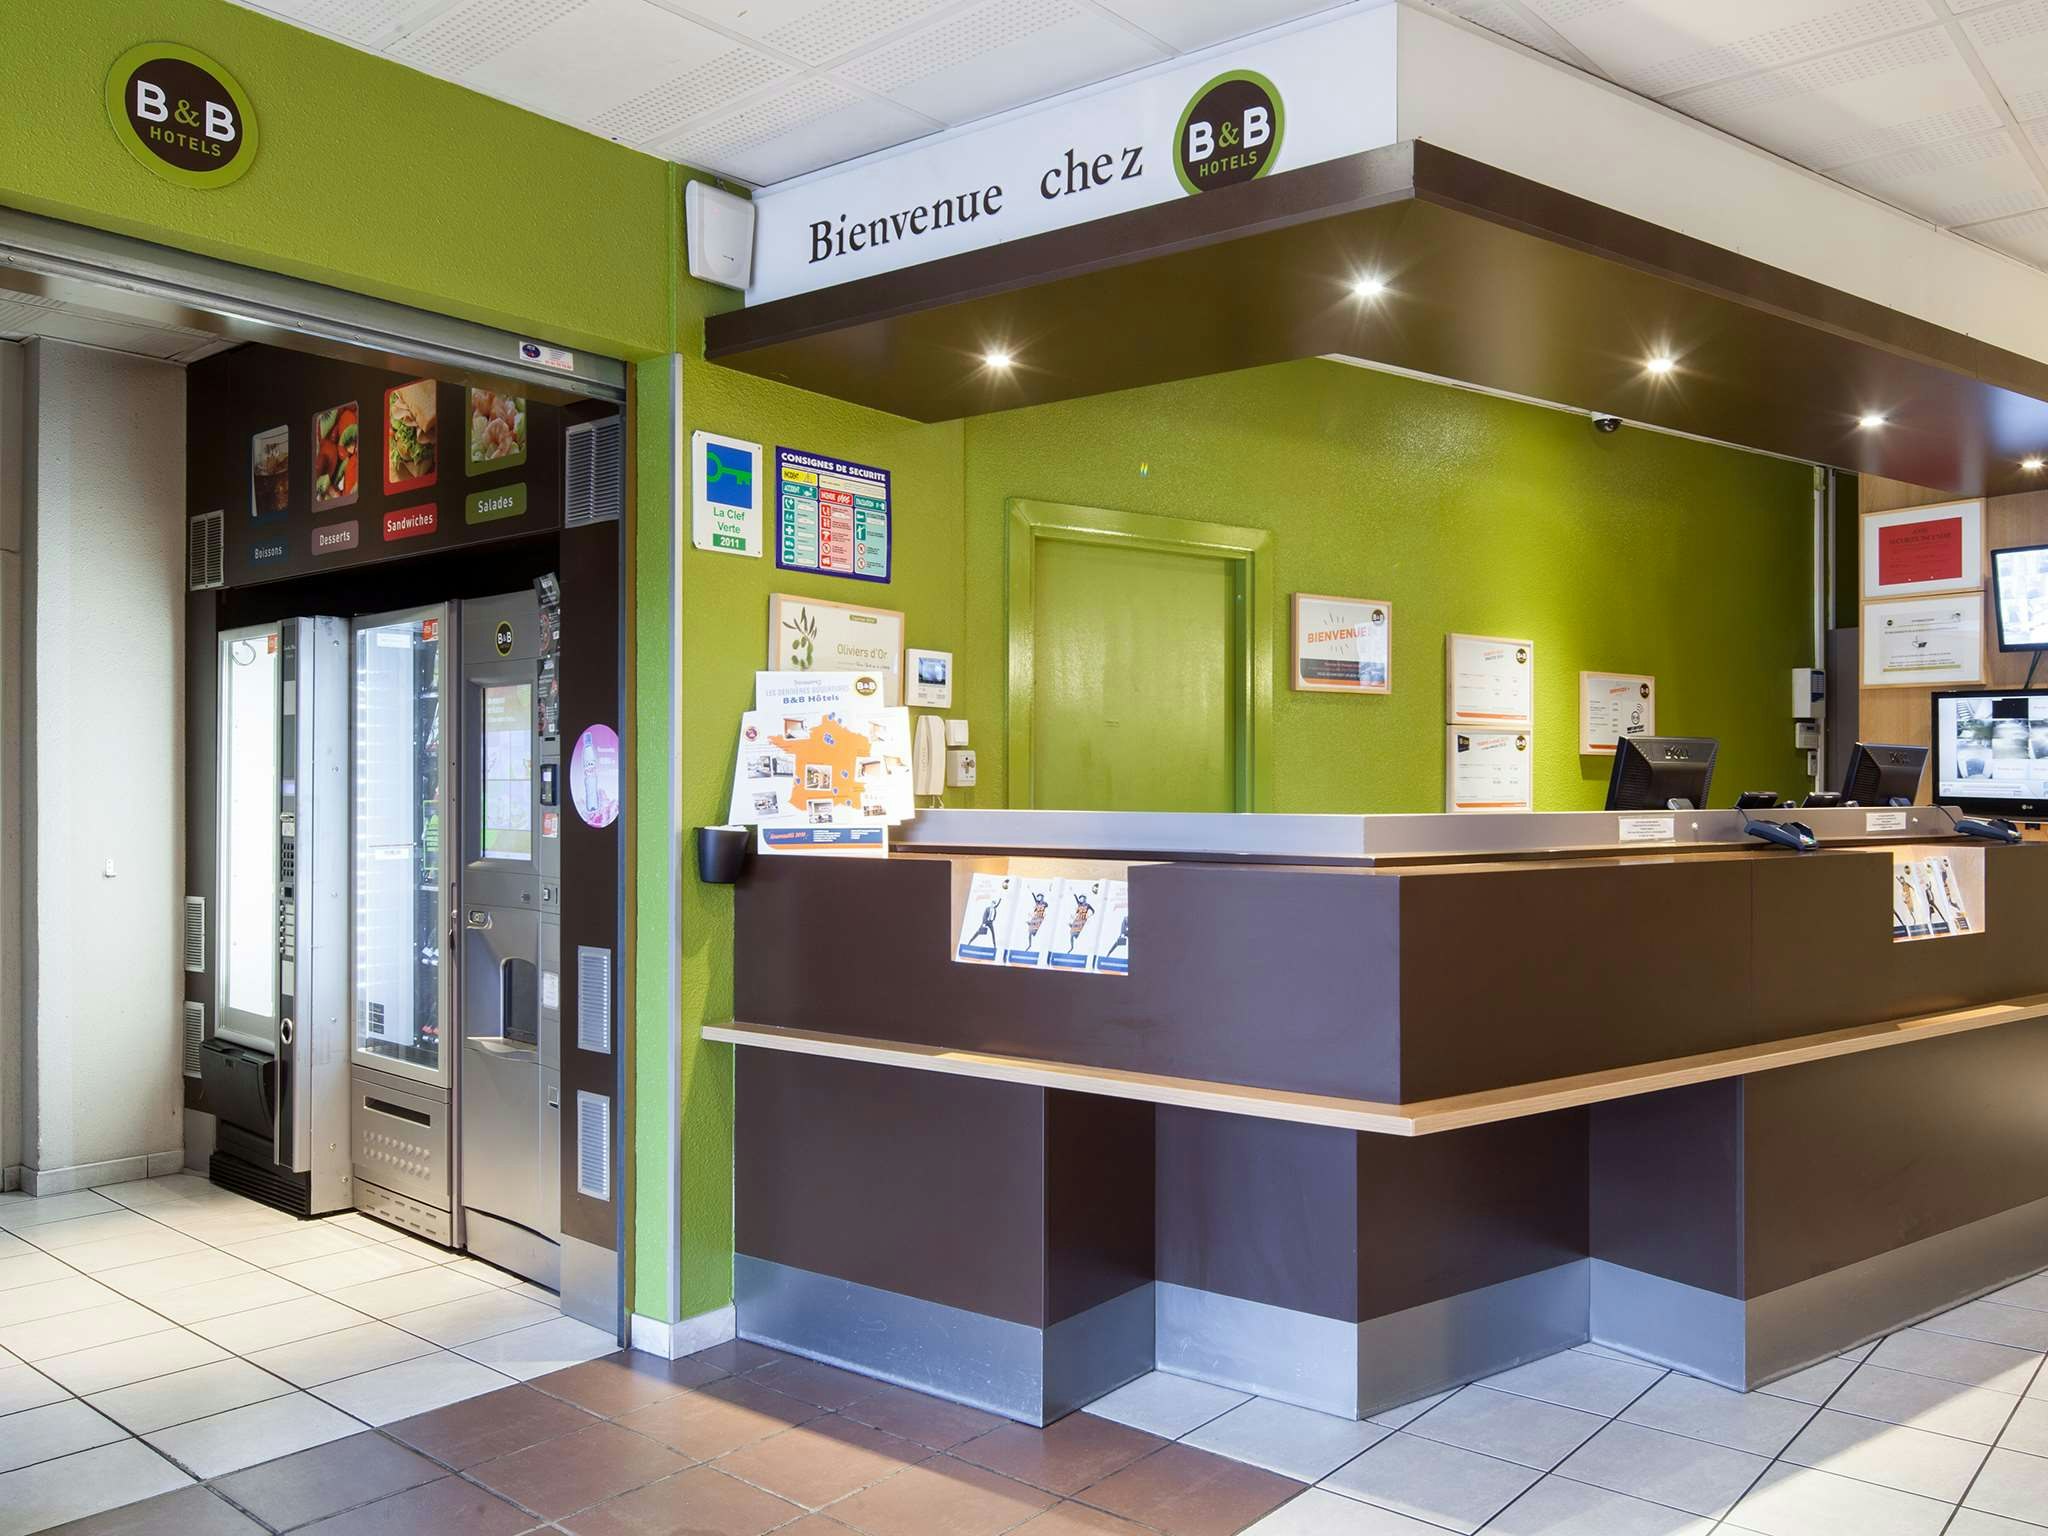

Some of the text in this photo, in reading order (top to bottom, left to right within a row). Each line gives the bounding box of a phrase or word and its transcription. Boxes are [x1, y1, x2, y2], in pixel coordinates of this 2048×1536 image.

[150, 126, 222, 157] HOTELS
[1199, 151, 1258, 177] HOTELS
[808, 145, 1143, 264] Bienvenue chez
[781, 452, 886, 482] CONSIGNES DE SECURITE
[477, 495, 514, 513] Salades
[713, 506, 745, 520] La Clef
[387, 513, 433, 533] Sandwiches
[717, 521, 741, 534] Verte
[319, 530, 351, 546] Desserts
[720, 536, 740, 548] 2011
[254, 544, 283, 560] Boissons
[1307, 627, 1368, 643] BIENVENUE
[837, 643, 888, 660] Oliviers d'Or
[808, 694, 839, 703] Hôtels
